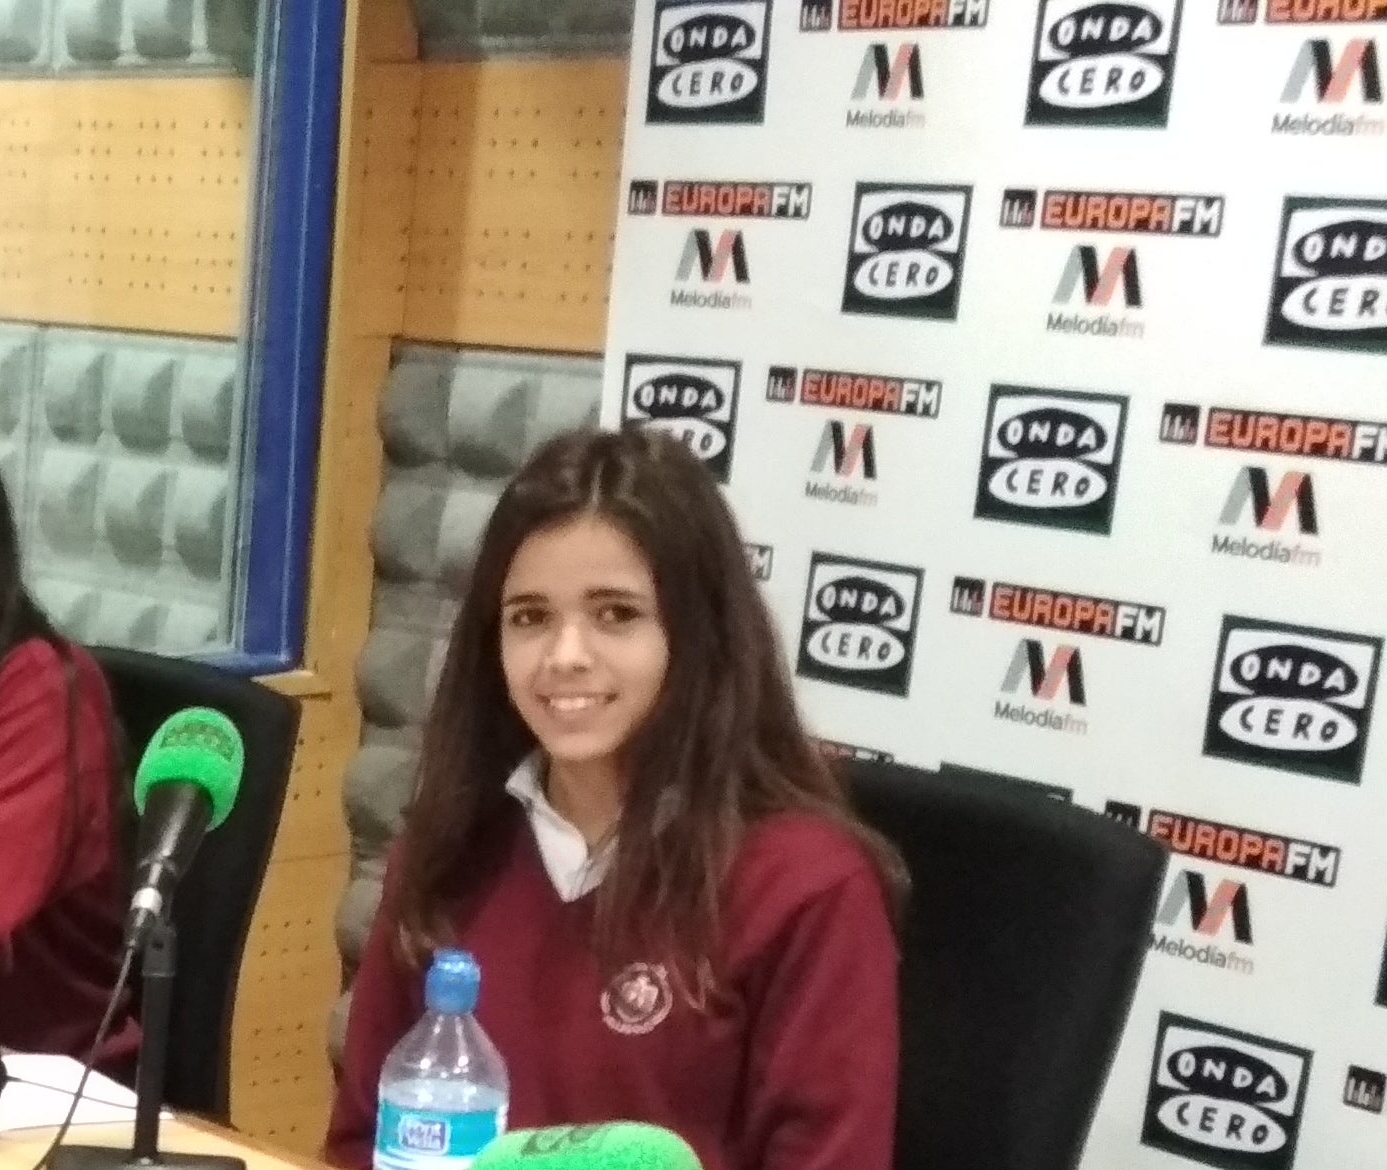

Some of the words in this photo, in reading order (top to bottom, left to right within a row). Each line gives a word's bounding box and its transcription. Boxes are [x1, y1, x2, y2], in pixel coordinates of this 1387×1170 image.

[670, 23, 749, 51] ONDA
[1057, 15, 1152, 46] ONDA
[672, 70, 744, 97] CERO
[1057, 66, 1146, 96] CERO
[869, 214, 946, 241] ONDA
[868, 262, 939, 289] CERO
[1303, 287, 1387, 318] CER
[640, 383, 718, 410] ONDA
[1006, 418, 1097, 450] ONDA
[1005, 467, 1091, 498] CERO
[821, 586, 898, 617] ONDA
[821, 630, 893, 662] CERO
[1239, 653, 1347, 692] ONDA
[1239, 704, 1339, 743] CERO
[1176, 1050, 1277, 1098] ONDA
[1176, 1102, 1269, 1147] CERO
